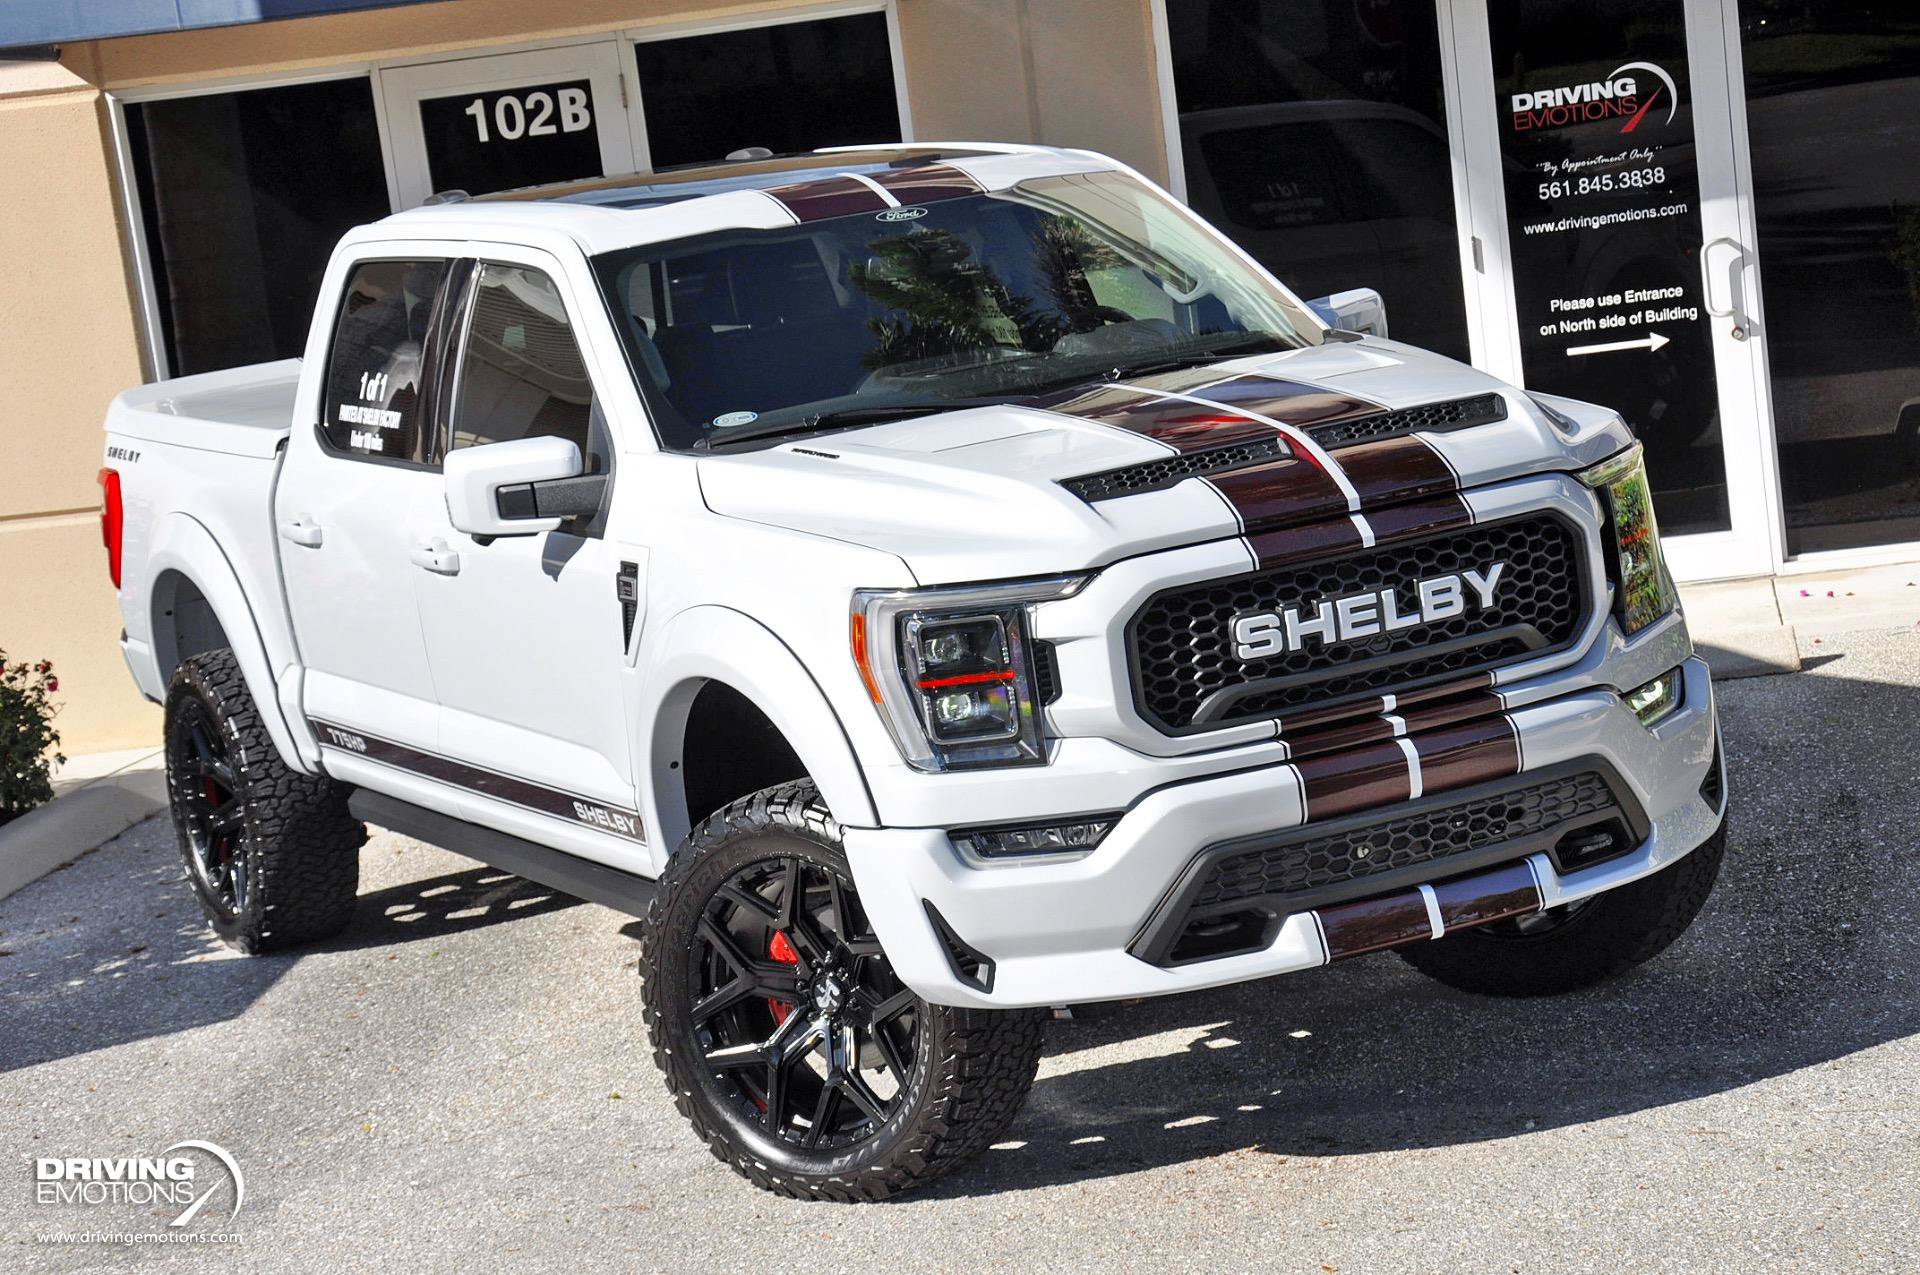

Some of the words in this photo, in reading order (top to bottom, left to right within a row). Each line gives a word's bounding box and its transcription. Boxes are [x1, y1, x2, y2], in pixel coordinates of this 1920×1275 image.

[1512, 77, 1637, 112] DRIVING
[465, 88, 591, 143] 102B
[1514, 95, 1638, 131] EMOTIONS
[1562, 151, 1627, 172] Appointment
[1538, 167, 1666, 200] 561.845.3838
[886, 209, 920, 221] Ford
[1524, 203, 1688, 235] www.drivingemotions.com
[1550, 297, 1594, 312] Please
[1598, 294, 1622, 307] use
[1625, 286, 1684, 303] Entrance
[1540, 324, 1557, 336] on
[1560, 317, 1596, 333] North
[1599, 314, 1626, 329] side
[1629, 311, 1642, 325] of
[1645, 306, 1698, 323] Building
[359, 371, 368, 400] 1
[366, 372, 382, 401] of
[379, 374, 388, 402] 1
[107, 446, 141, 463] SHELBY
[1231, 560, 1505, 661] SHELBY
[573, 801, 636, 834] SHELBY
